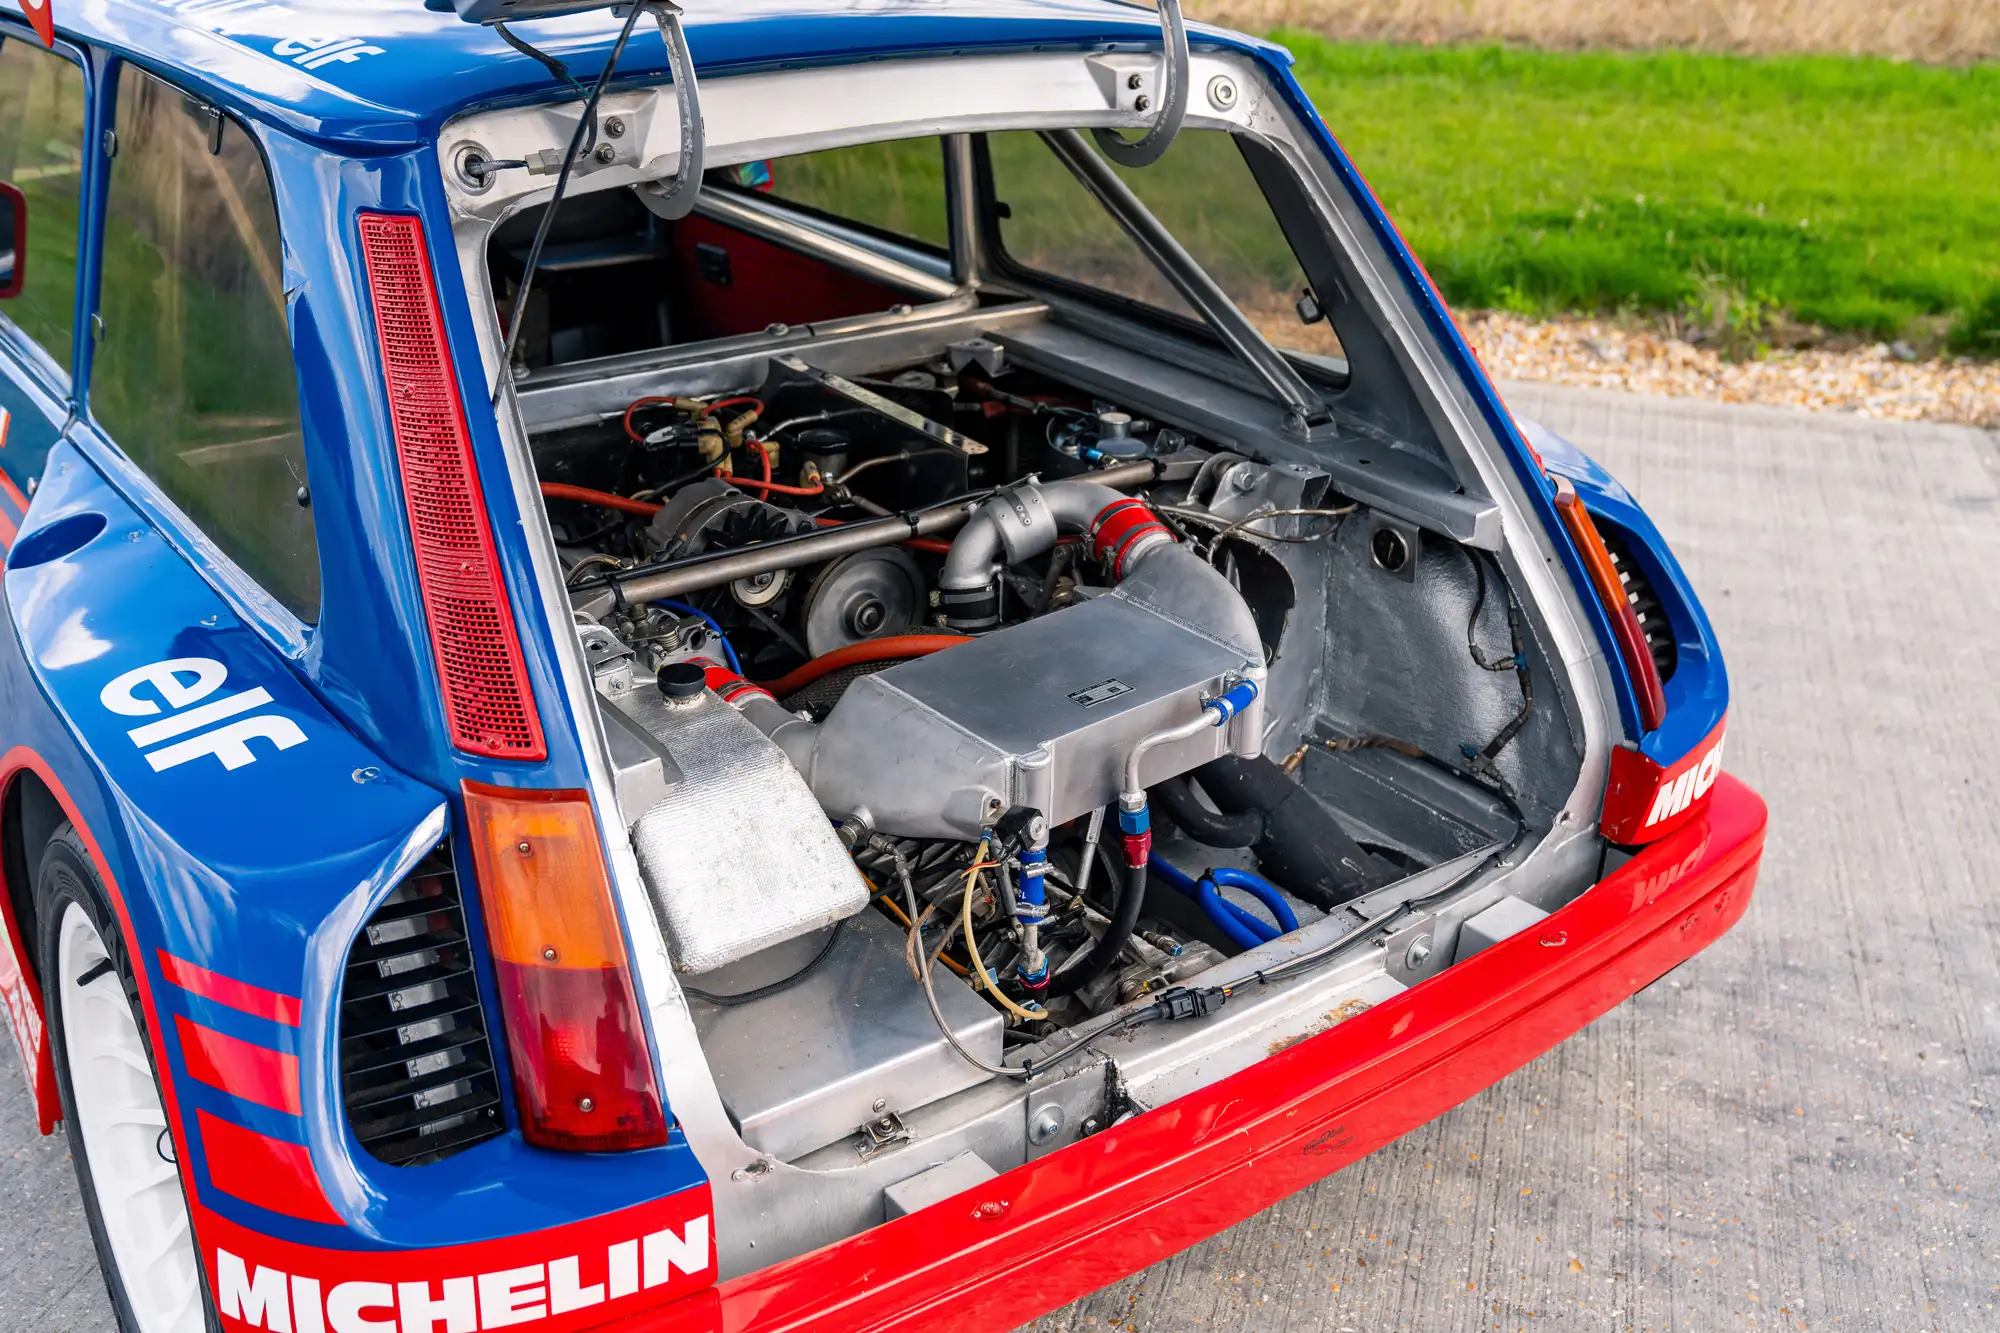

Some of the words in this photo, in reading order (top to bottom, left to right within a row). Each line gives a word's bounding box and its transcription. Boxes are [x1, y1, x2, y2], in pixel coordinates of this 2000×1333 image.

[272, 31, 387, 71] elf
[100, 657, 309, 773] elf
[216, 1213, 709, 1333] MICHELIN
